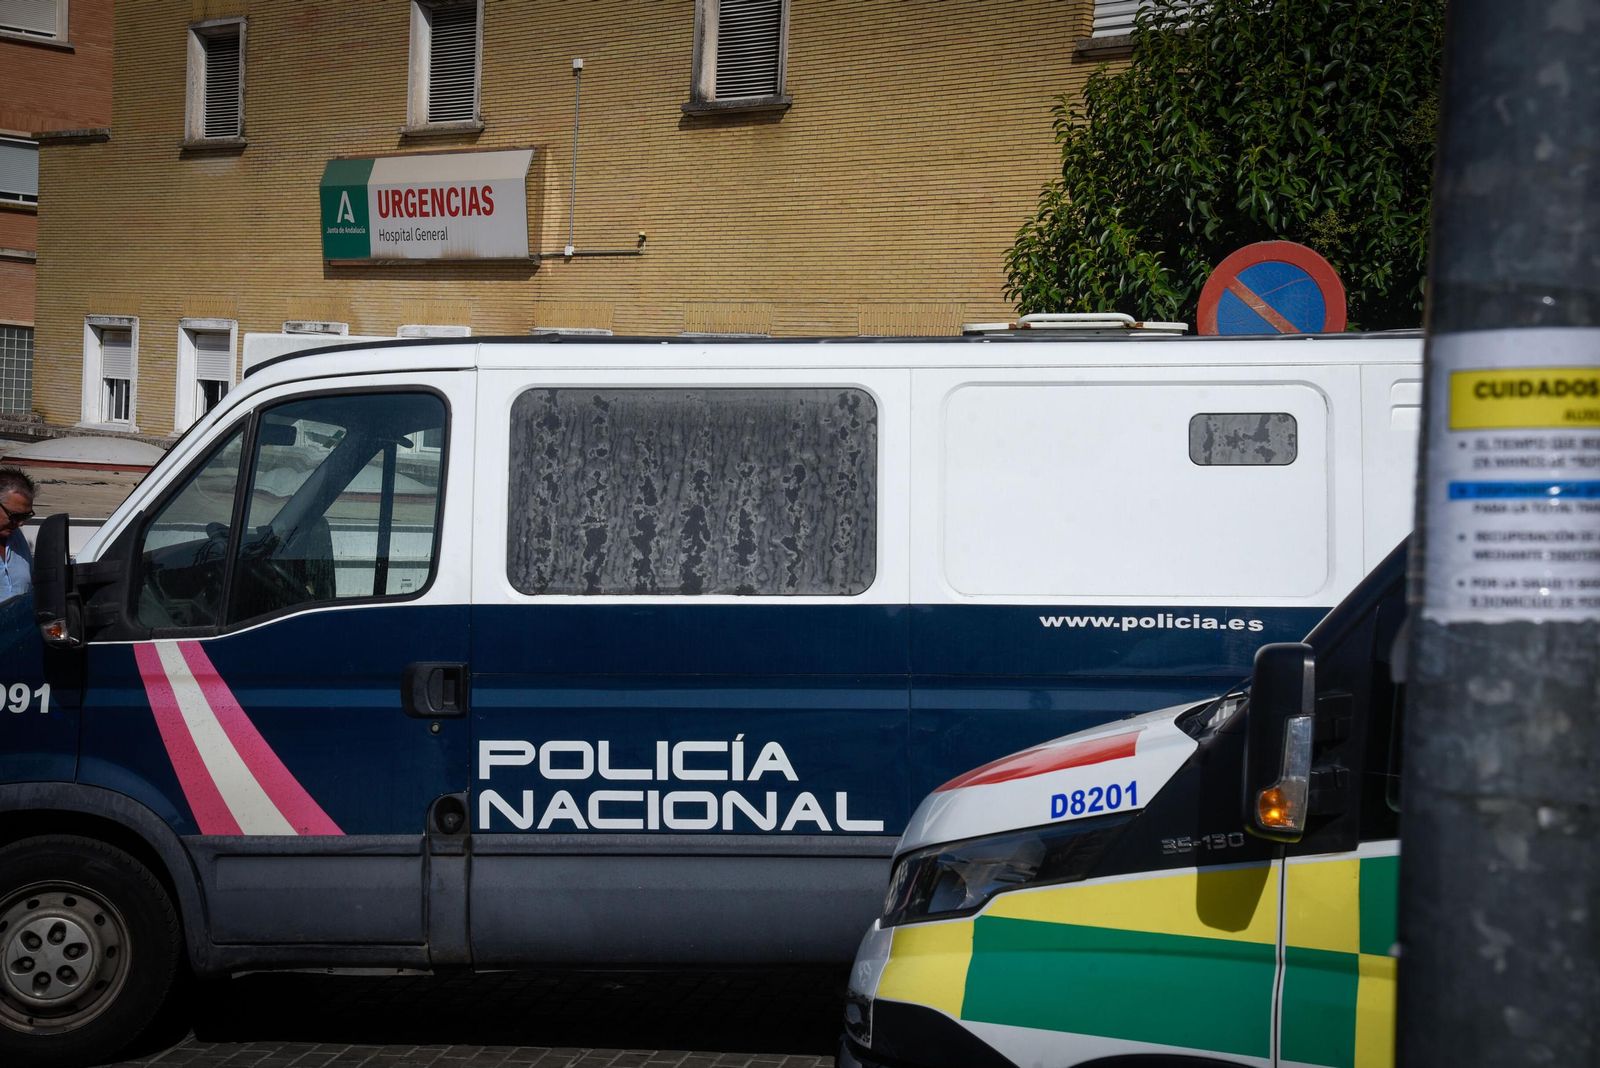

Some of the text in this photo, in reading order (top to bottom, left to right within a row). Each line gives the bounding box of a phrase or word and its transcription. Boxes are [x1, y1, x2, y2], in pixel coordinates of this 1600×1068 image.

[377, 185, 495, 219] URGENCIAS
[379, 226, 449, 245] Hospital General
[1474, 378, 1599, 400] CUIDADOS
[1039, 612, 1265, 632] www.policia.es
[0, 683, 51, 714] 91
[478, 733, 800, 782] POLICÍA
[478, 789, 885, 832] NACIONAL
[1050, 780, 1138, 820] D8201
